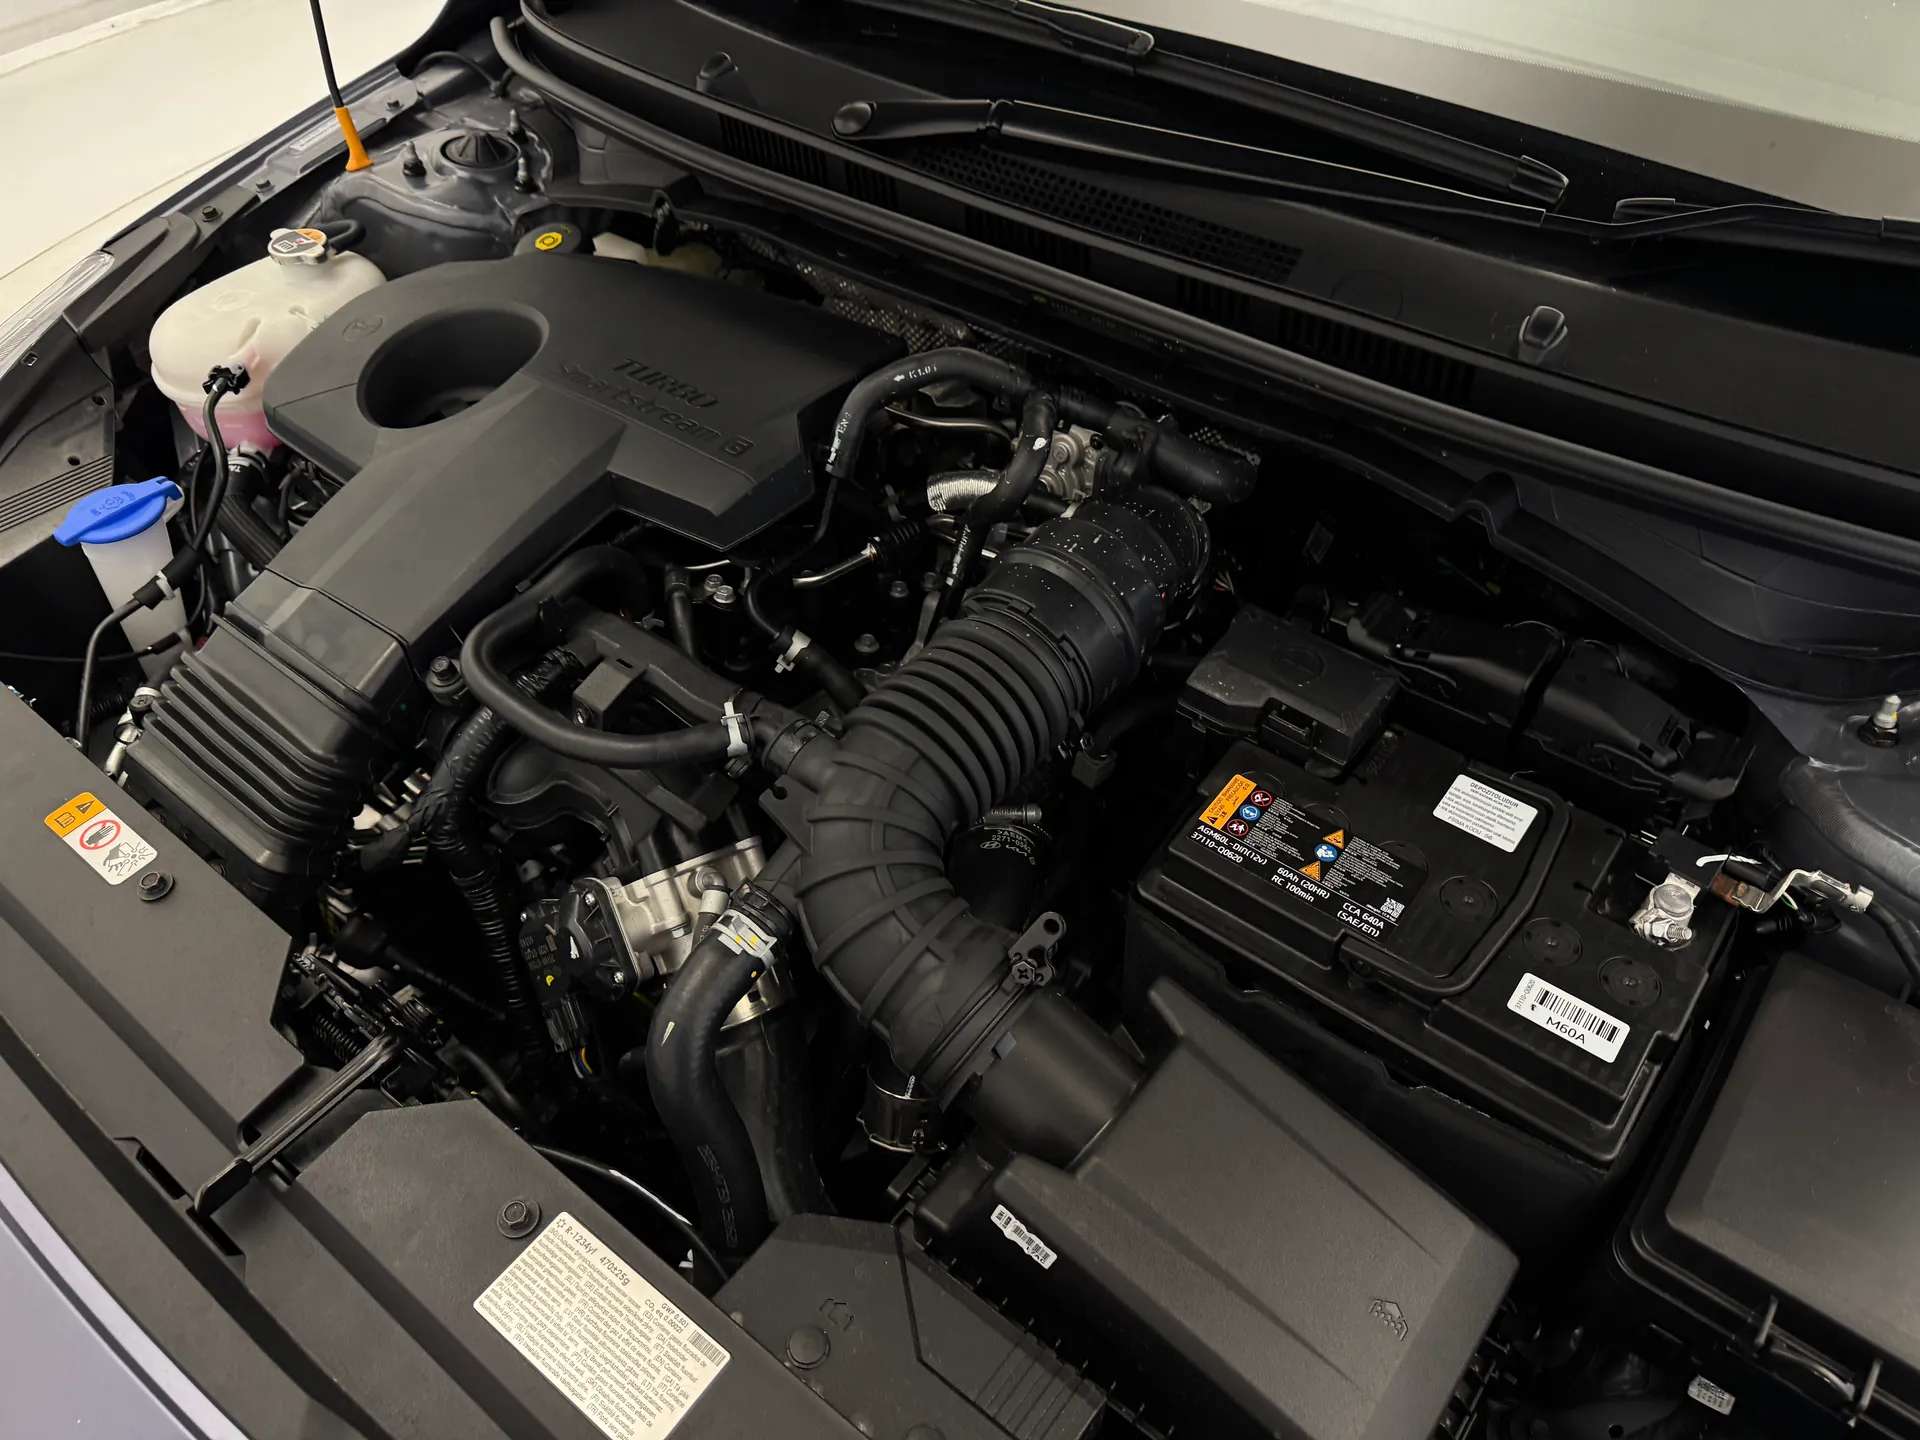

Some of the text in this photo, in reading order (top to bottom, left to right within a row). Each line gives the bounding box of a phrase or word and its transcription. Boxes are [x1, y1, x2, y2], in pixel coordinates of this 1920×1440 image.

[614, 358, 719, 408] TURBO
[1190, 831, 1243, 864] 37110-Q0620
[1270, 875, 1285, 886] RC
[1284, 882, 1315, 902] 100min
[1276, 866, 1300, 883] 60Ah
[1298, 878, 1331, 900] (20HR)
[1341, 901, 1362, 917] CCA
[1360, 911, 1385, 929] 640A
[1544, 1015, 1588, 1044] M60A
[597, 1255, 631, 1287] 470±25g
